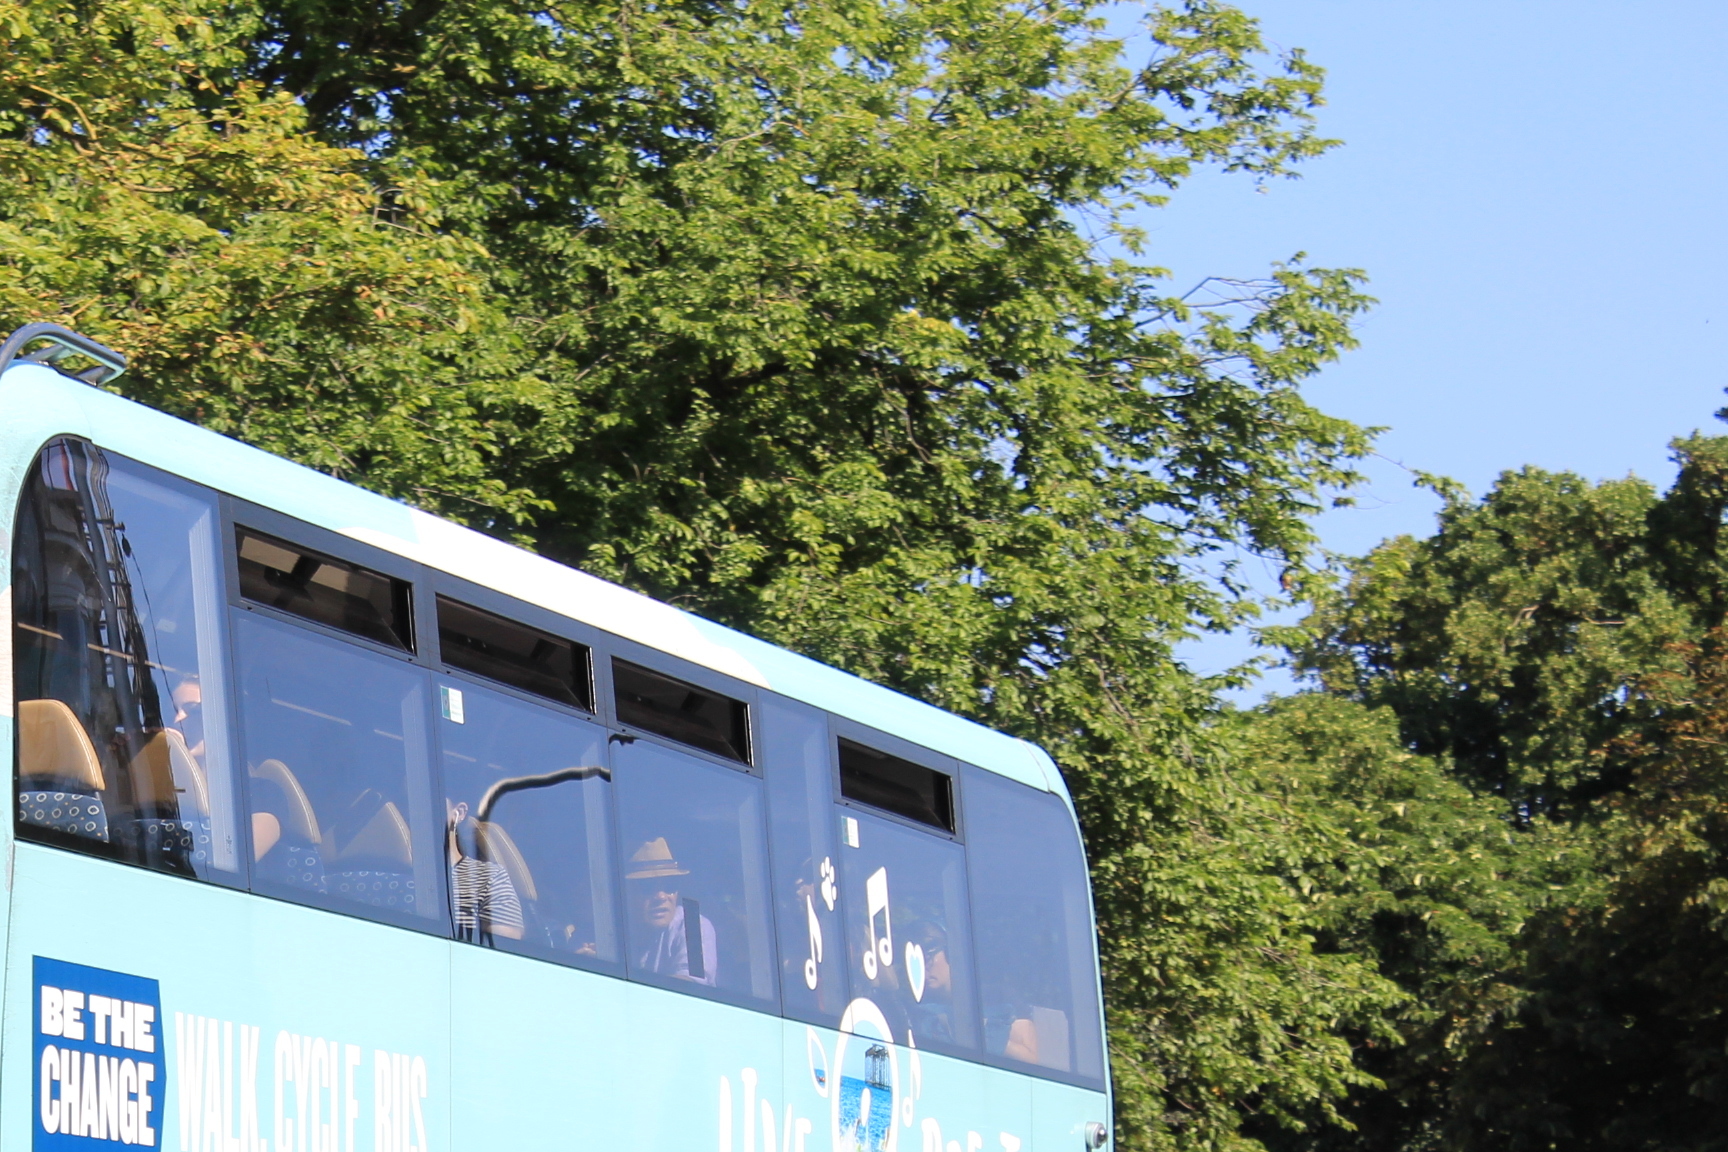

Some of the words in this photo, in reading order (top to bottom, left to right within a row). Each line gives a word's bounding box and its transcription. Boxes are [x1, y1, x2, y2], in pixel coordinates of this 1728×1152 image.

[40, 985, 85, 1042] BE
[89, 994, 155, 1054] THE
[40, 1044, 155, 1147] CHANGE
